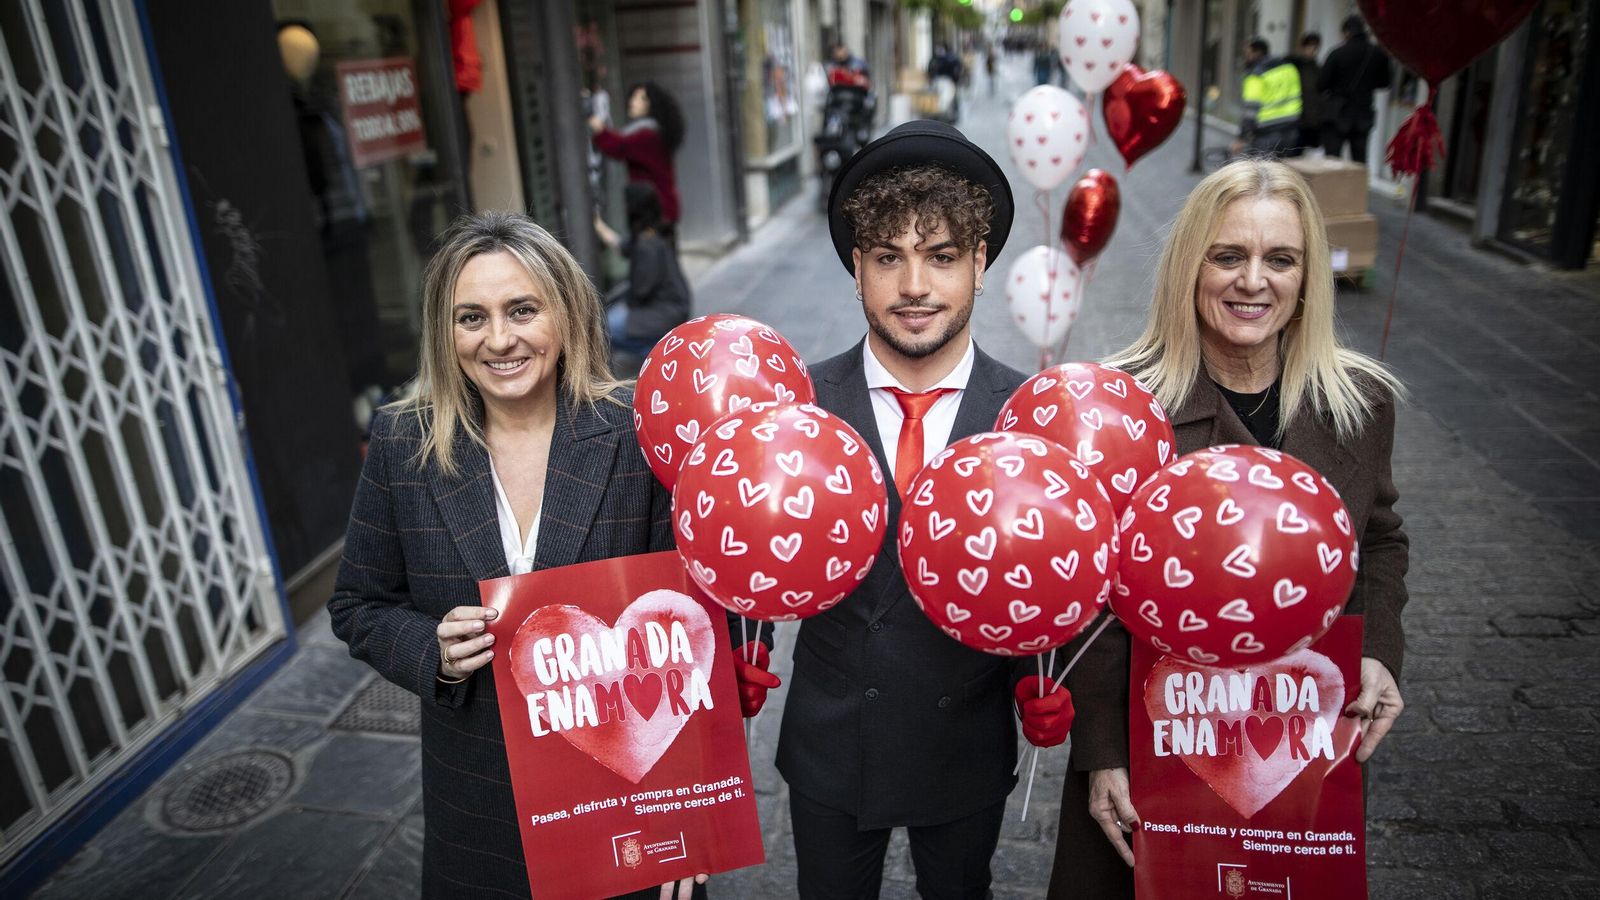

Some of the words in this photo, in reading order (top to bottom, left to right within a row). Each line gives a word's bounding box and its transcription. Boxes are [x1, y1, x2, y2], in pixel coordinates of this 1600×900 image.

[345, 68, 414, 105] REBAJAS
[533, 620, 694, 686] GRANADA
[1164, 671, 1320, 715] GRANADA
[531, 810, 571, 826] Pasea,
[573, 799, 618, 816] disfruta
[620, 796, 628, 806] y
[630, 789, 674, 803] compra
[676, 786, 690, 796] en
[692, 775, 744, 794] Granada.
[634, 802, 682, 815] Siempre
[684, 798, 715, 809] cerca
[718, 792, 732, 803] de
[734, 787, 746, 798] ti.
[1144, 821, 1181, 834] Pasea,
[1184, 823, 1227, 835] disfruta
[1230, 828, 1237, 838] y
[1240, 828, 1284, 840] compra
[1287, 831, 1301, 840] en
[1304, 830, 1356, 841] Granada.
[1243, 840, 1291, 854] Siempre
[1294, 845, 1326, 855] cerca
[1329, 844, 1343, 855] de
[1345, 844, 1356, 854] ti.
